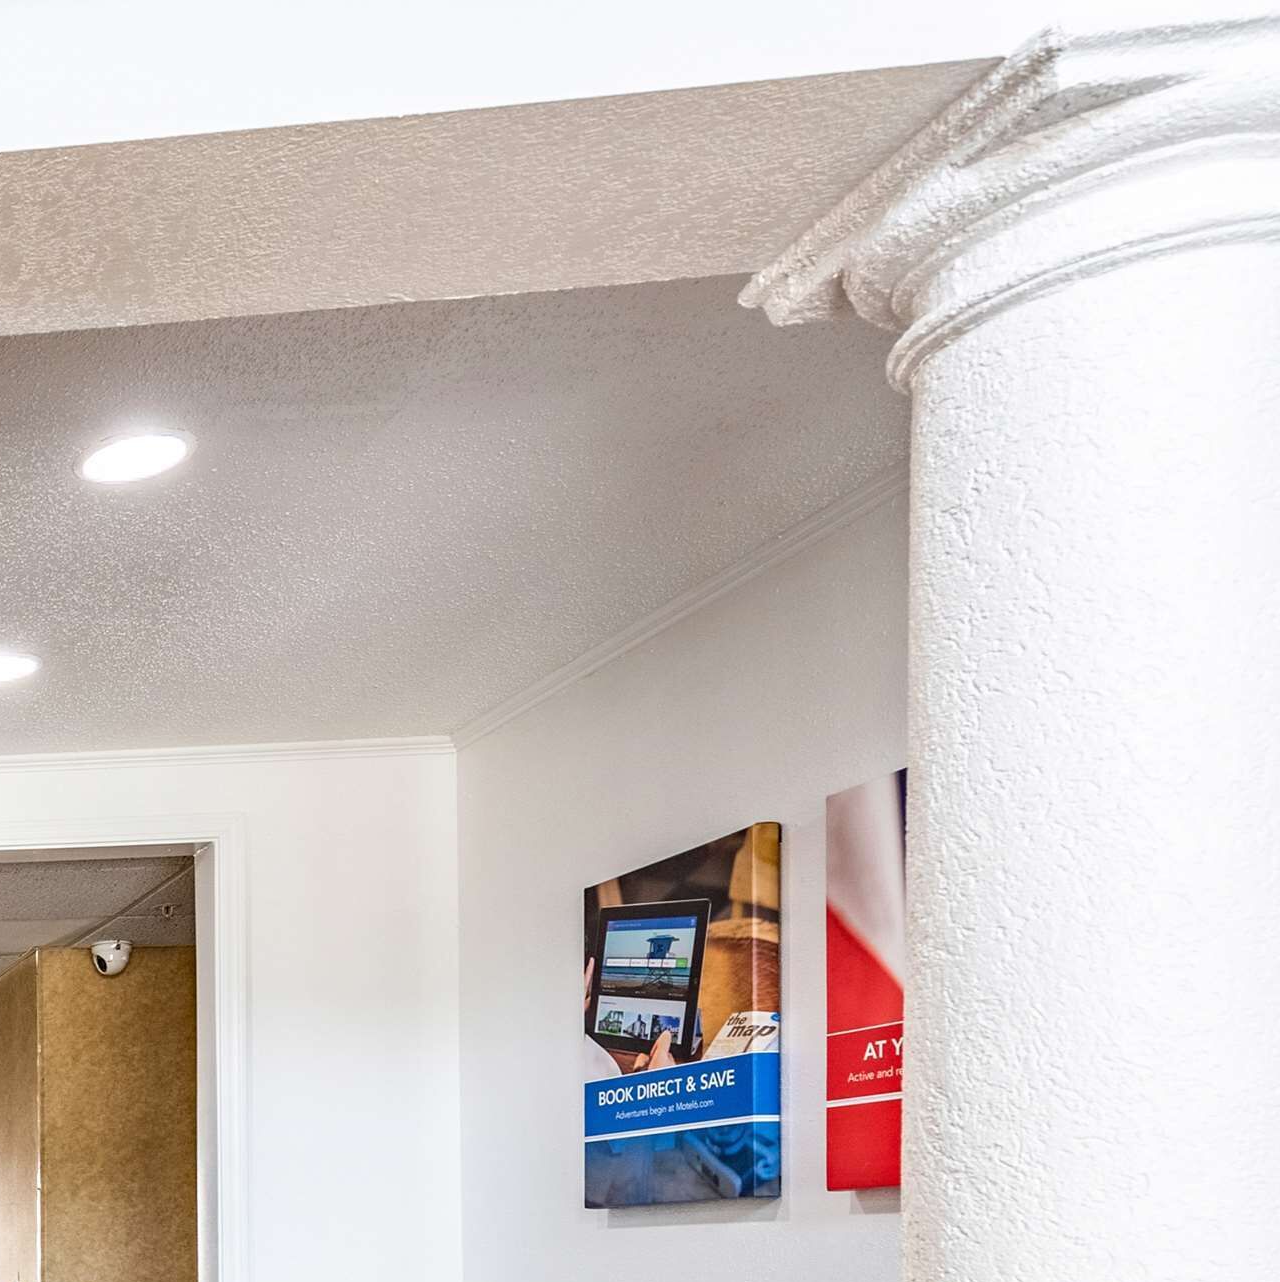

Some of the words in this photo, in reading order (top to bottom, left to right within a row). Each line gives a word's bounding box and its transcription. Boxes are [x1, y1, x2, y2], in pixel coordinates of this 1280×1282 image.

[727, 1012, 747, 1026] the
[727, 1024, 777, 1052] map
[863, 1040, 887, 1061] AT
[847, 1070, 875, 1083] Active
[876, 1066, 894, 1079] and
[598, 1086, 634, 1106] BOOK
[637, 1078, 682, 1100] DIRECT
[685, 1076, 696, 1093] &
[700, 1069, 736, 1090] SAVE
[615, 1107, 649, 1120] Adventures
[649, 1104, 667, 1116] begin
[667, 1103, 675, 1113] at
[675, 1099, 715, 1111] Motel6.com
